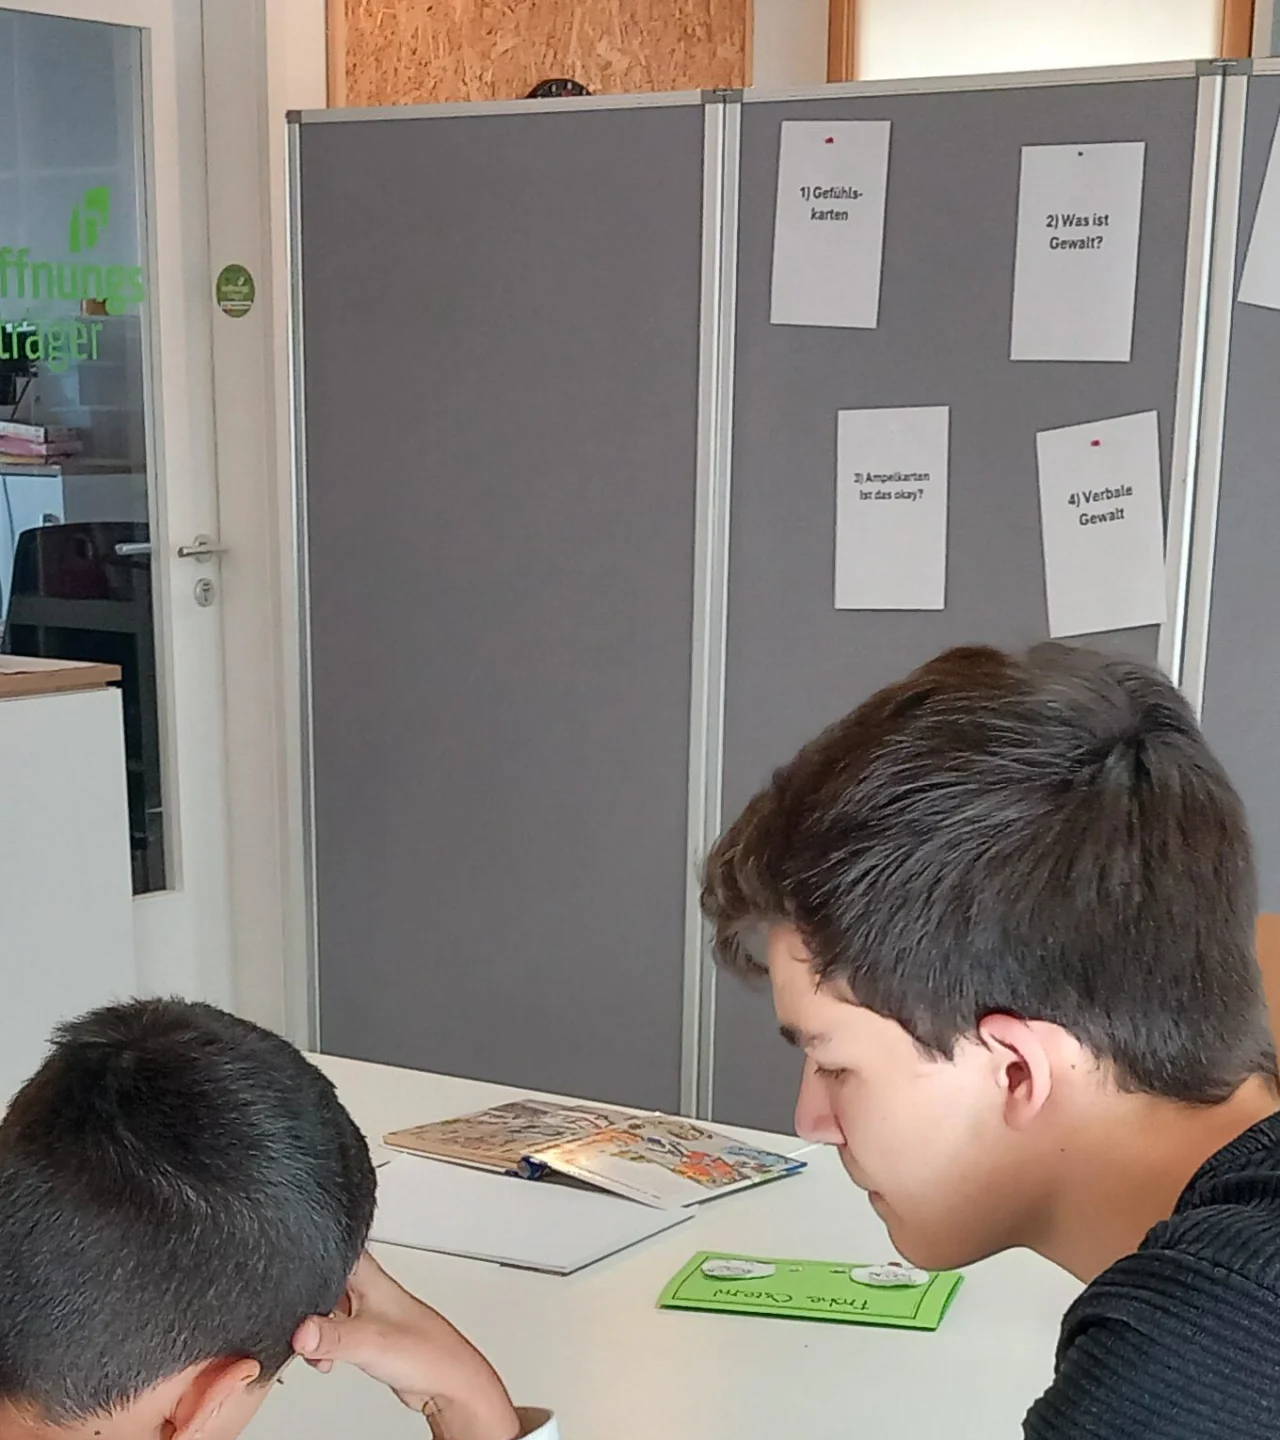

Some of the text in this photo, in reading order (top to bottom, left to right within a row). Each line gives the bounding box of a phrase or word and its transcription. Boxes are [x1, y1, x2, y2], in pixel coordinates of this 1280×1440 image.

[799, 185, 863, 201] 1) Gefühls-
[810, 206, 849, 221] karten
[1045, 212, 1109, 230] 2) Was ist
[1048, 235, 1104, 250] Gewalt?
[1068, 484, 1133, 508] 4) Verbale
[1079, 507, 1125, 526] Gewalt
